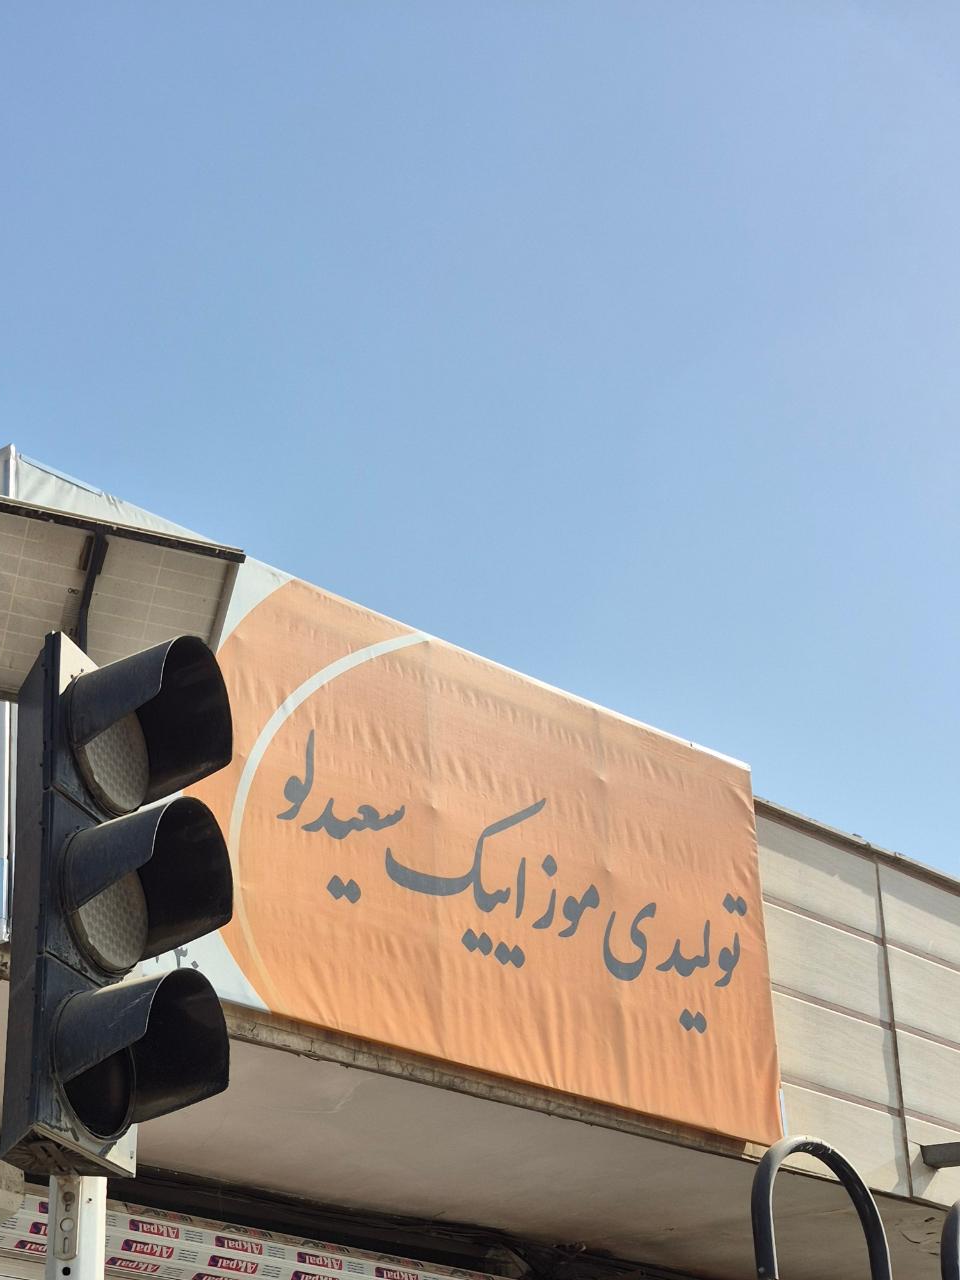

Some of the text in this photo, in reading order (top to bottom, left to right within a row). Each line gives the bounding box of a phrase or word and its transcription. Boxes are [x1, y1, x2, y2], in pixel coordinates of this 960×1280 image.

[276, 729, 749, 1035] تولیدی موزاییک سعیدلو
[142, 1221, 180, 1240] Akpal
[131, 1239, 175, 1260] Akpal
[224, 1238, 264, 1256] Akpal
[117, 1257, 161, 1273] Akpal
[217, 1256, 260, 1276] Akpal
[305, 1253, 344, 1271] Akpal
